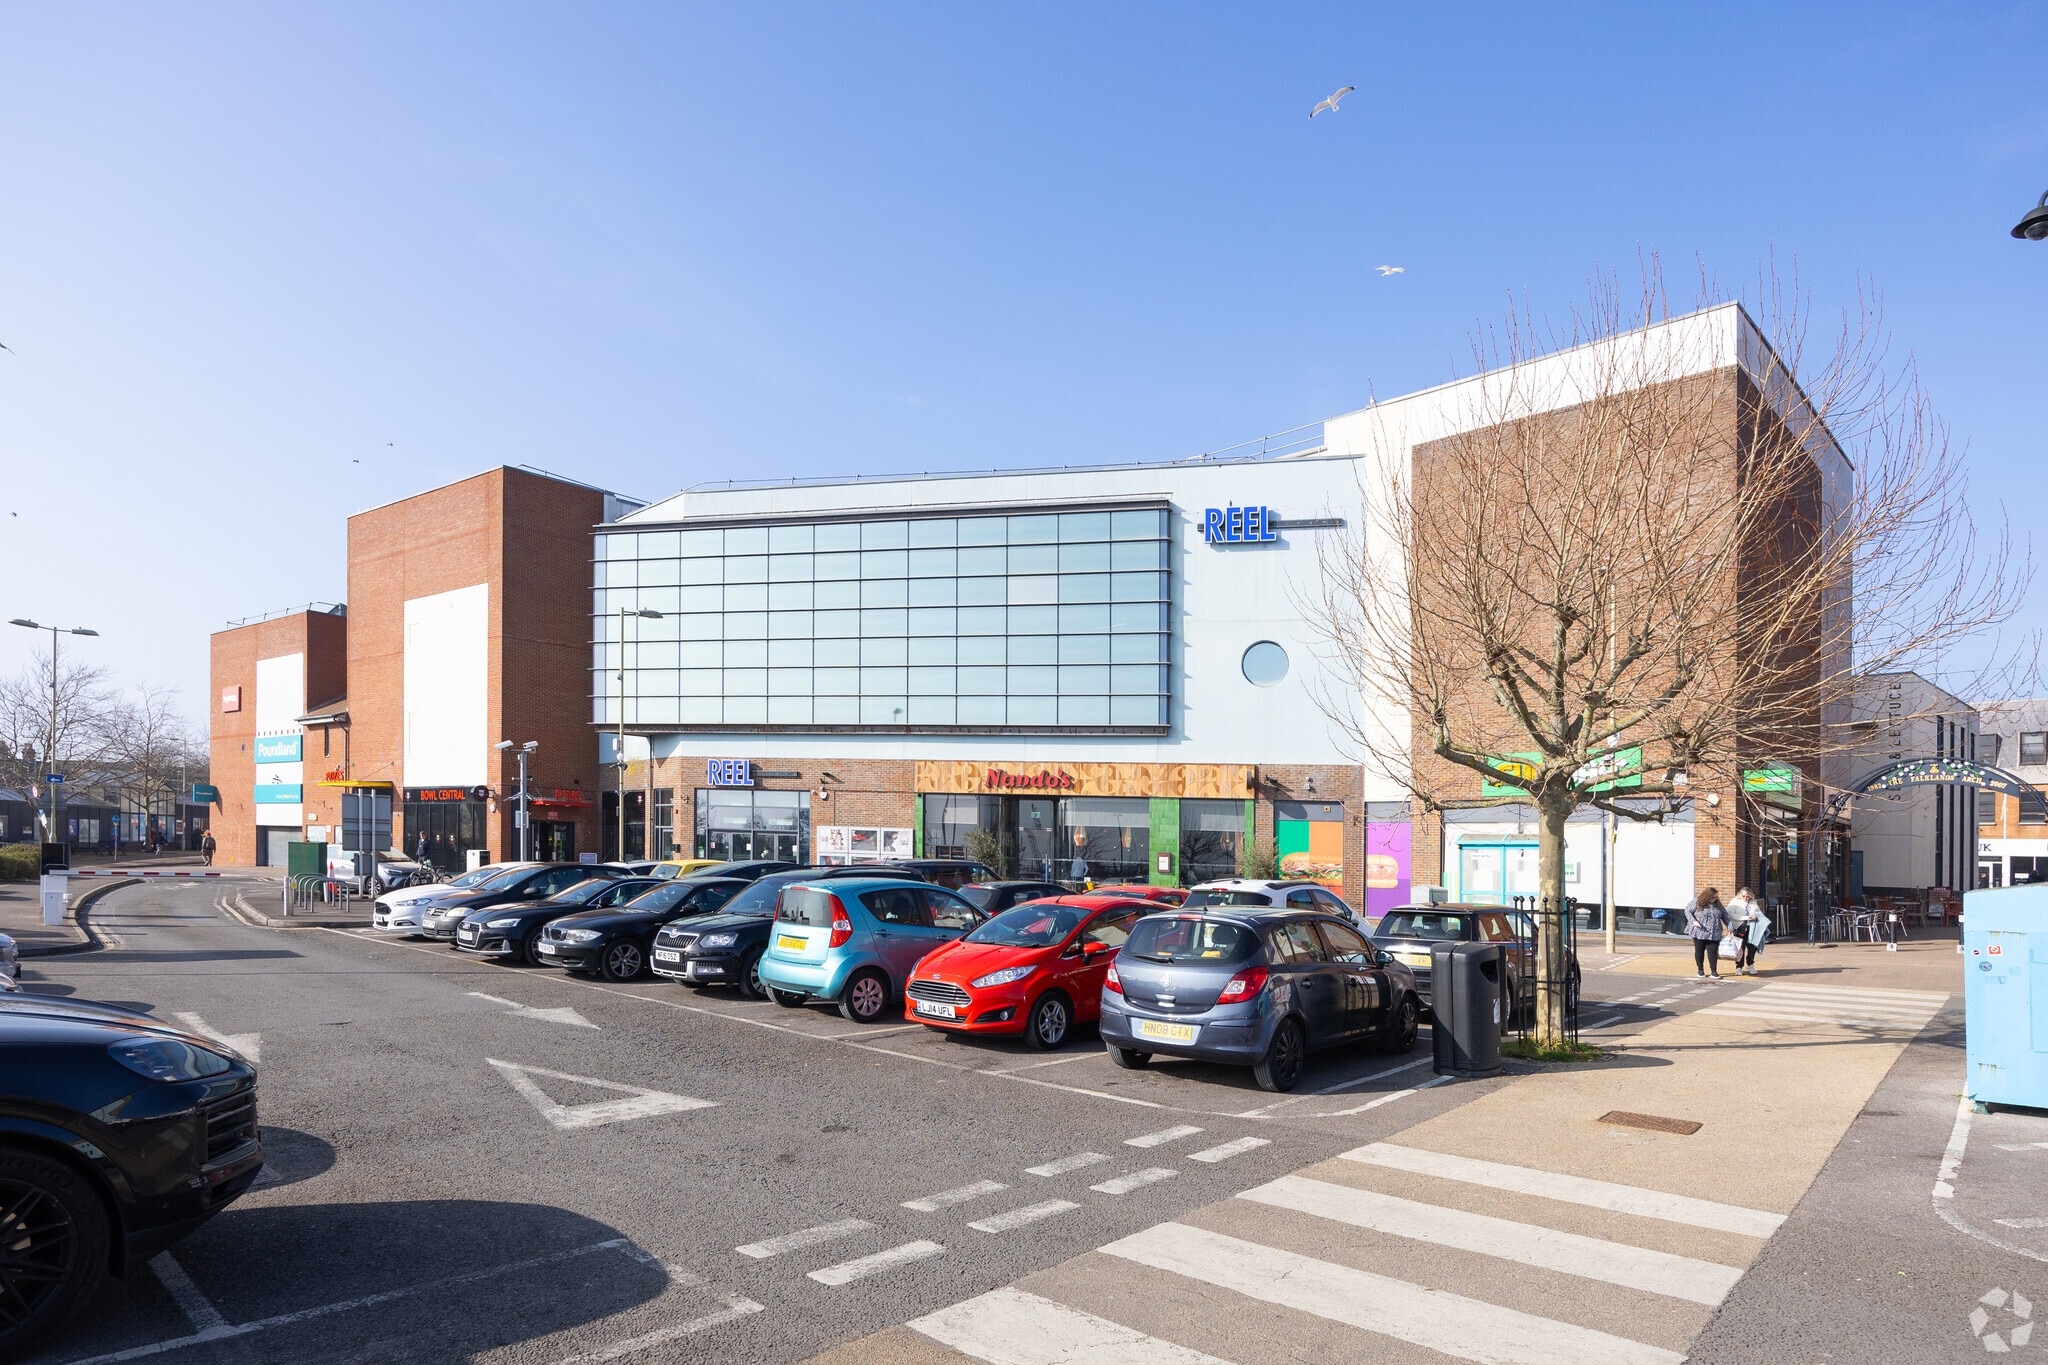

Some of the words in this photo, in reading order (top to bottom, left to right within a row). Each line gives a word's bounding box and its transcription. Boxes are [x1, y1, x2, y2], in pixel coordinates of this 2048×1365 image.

[1204, 505, 1277, 543] REEL
[1889, 683, 1902, 747] LETTUCE
[258, 742, 298, 757] Poundland
[708, 759, 754, 786] REEL
[985, 766, 1071, 789] Nando's
[1888, 778, 1904, 786] THE
[1910, 774, 1956, 783] FALKLANDS
[1961, 776, 1982, 785] ARCH
[1989, 780, 2008, 790] 2007
[420, 790, 437, 801] BOWL
[438, 789, 466, 800] CENTRAL
[555, 788, 583, 802] PINS
[922, 1002, 937, 1014] LJ14
[1144, 1024, 1169, 1035] HN08
[1171, 1026, 1190, 1038] CTX
